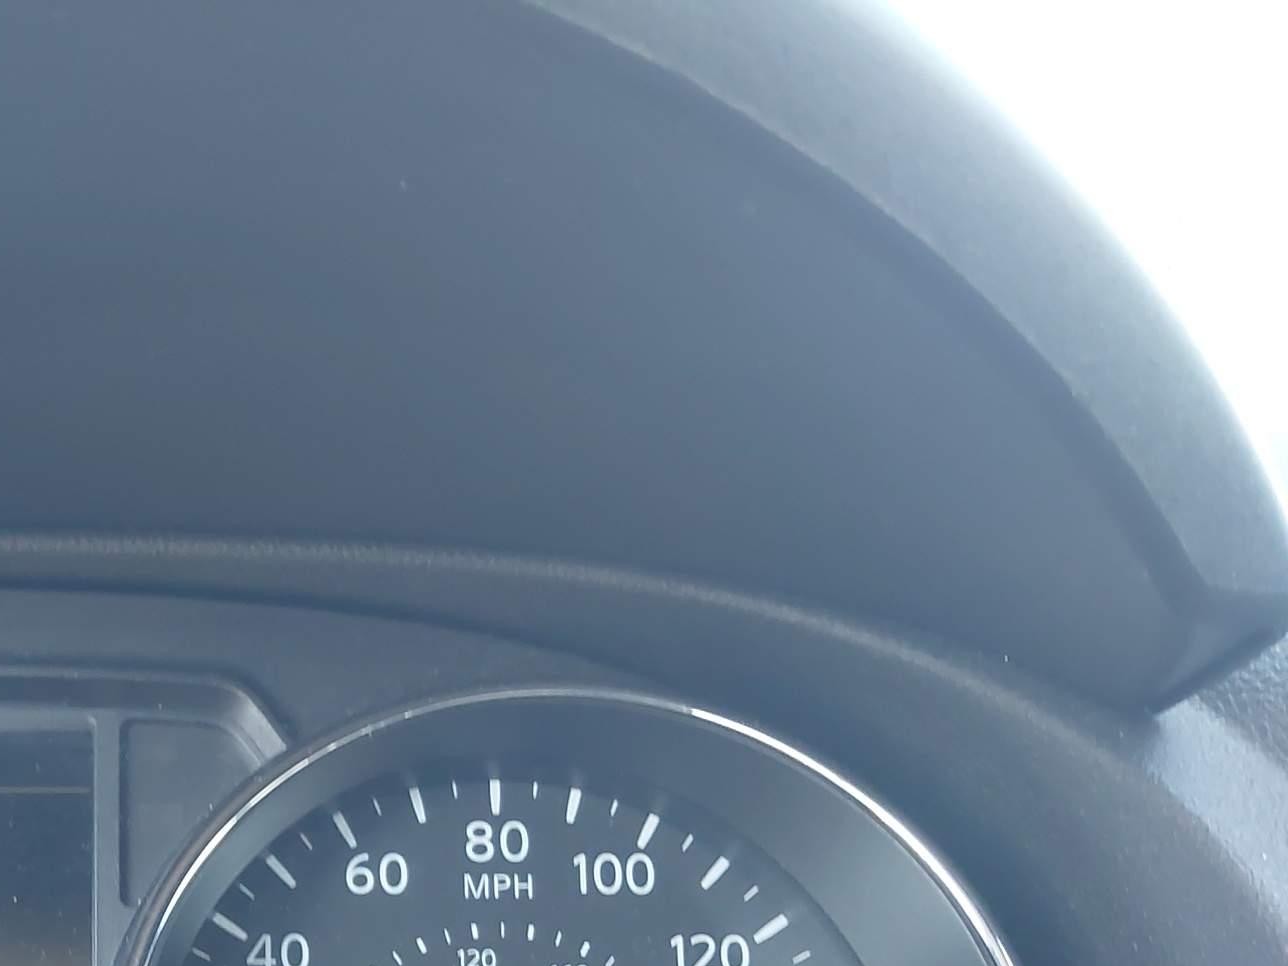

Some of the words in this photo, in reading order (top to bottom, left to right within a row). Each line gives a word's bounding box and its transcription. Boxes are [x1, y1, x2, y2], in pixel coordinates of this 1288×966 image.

[465, 820, 530, 863] 80
[345, 852, 408, 895] 60
[463, 873, 534, 900] MPH
[573, 852, 655, 895] 100
